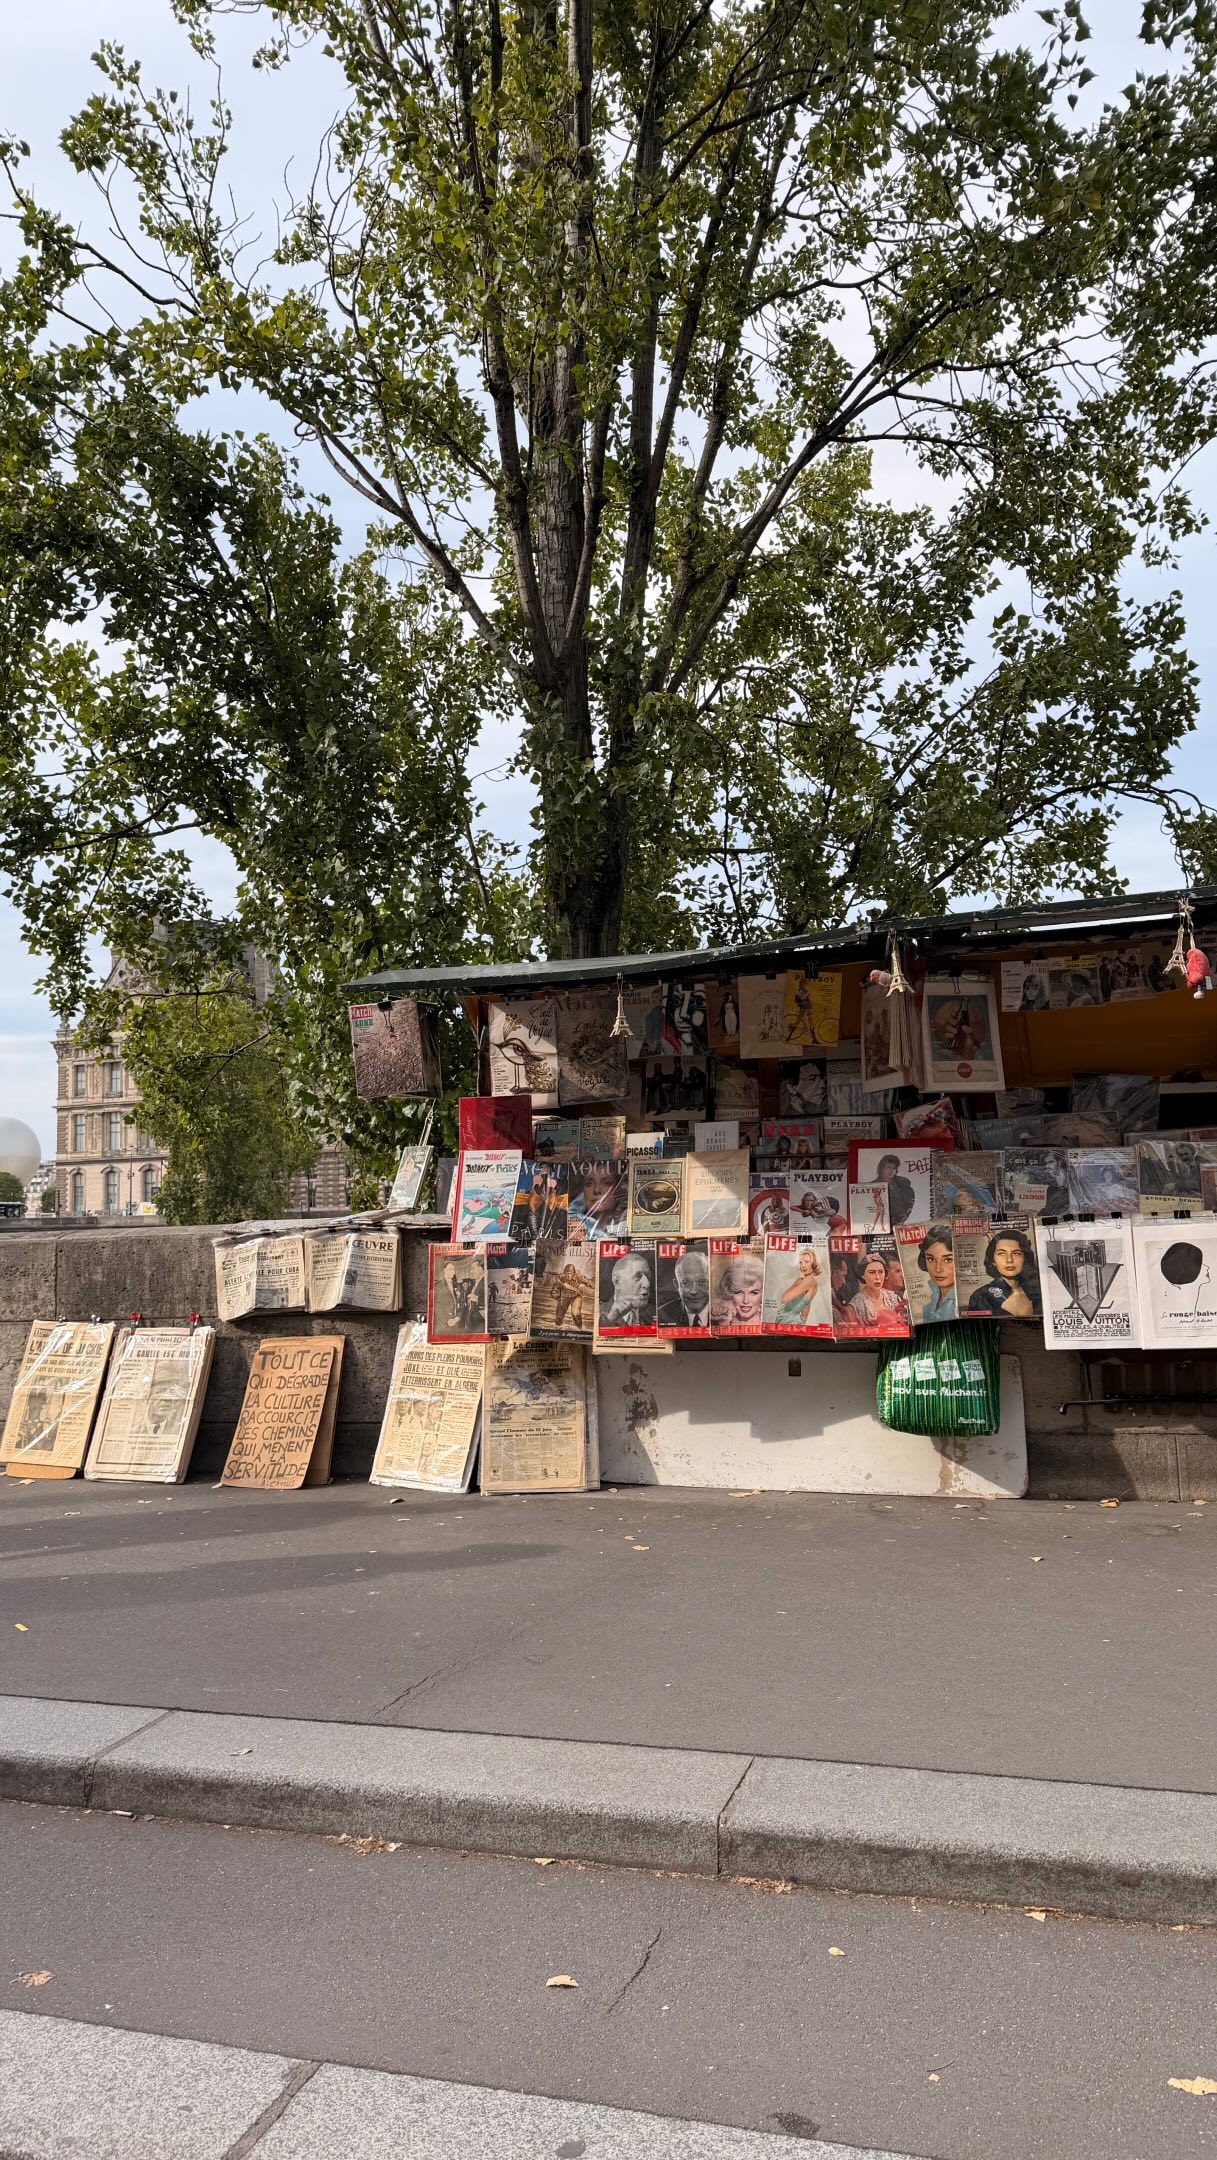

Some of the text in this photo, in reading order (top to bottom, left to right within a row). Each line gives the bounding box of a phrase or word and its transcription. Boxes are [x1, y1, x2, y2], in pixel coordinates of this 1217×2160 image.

[795, 974, 835, 983] PBOY
[626, 1147, 658, 1156] PICASSO
[571, 1160, 629, 1176] VOGUE
[793, 1173, 844, 1183] PLAYBOY
[898, 1225, 926, 1242] MATCH
[964, 1226, 983, 1234] MONDE
[603, 1243, 626, 1255] LIFE
[712, 1241, 737, 1252] LIFE
[768, 1236, 796, 1251] LIFE
[831, 1238, 859, 1252] LIFE
[659, 1244, 686, 1257] LIFE
[285, 1266, 300, 1274] CUBA
[1053, 1318, 1083, 1326] LOUIS
[513, 1340, 553, 1350] Le Canard
[136, 1349, 161, 1359] GAULLE
[162, 1350, 176, 1359] EST
[455, 1354, 484, 1366] POUVOIRS
[258, 1350, 332, 1371] TOUT CE
[403, 1363, 420, 1373] JOXE
[436, 1365, 445, 1375] ET
[275, 1371, 329, 1390] DÉGRADE
[401, 1375, 442, 1388] ATTERRISSENT
[444, 1378, 453, 1388] EN
[893, 1386, 987, 1397] RDV SUR Auchan.fr
[244, 1392, 323, 1410] LA CULTURE
[240, 1410, 319, 1425] RACCOURCIT
[958, 1416, 985, 1424] Auchan
[236, 1423, 317, 1441] LES CHEMINS
[232, 1441, 257, 1456] QUI
[269, 1452, 286, 1463] LA
[223, 1460, 309, 1480] SERVITUDE
